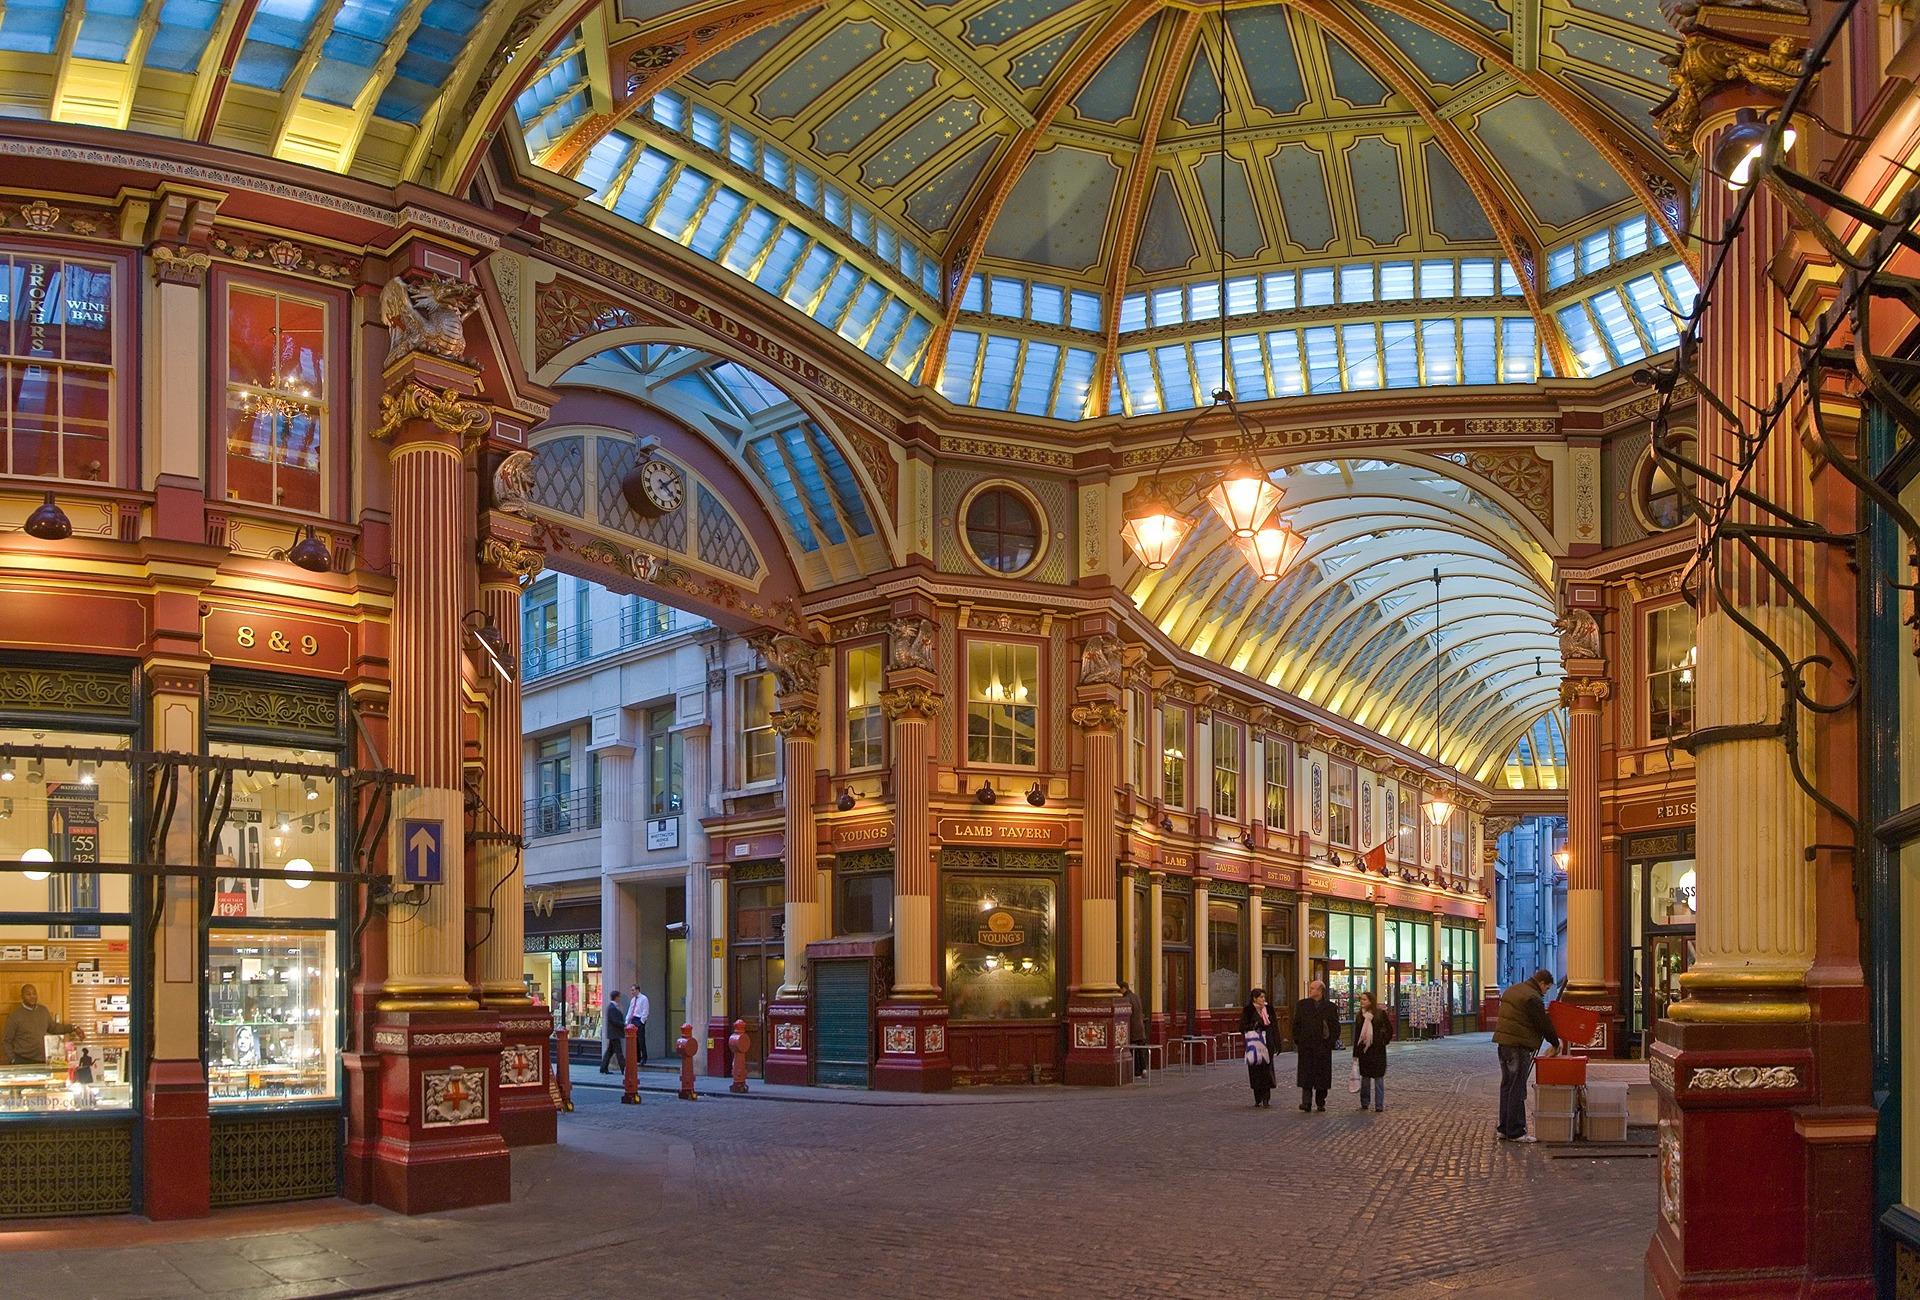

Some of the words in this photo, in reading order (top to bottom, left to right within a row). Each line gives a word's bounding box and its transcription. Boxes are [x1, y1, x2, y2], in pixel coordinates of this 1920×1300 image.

[30, 264, 45, 350] BROKERS
[66, 300, 110, 312] WINE
[73, 311, 104, 322] BAR
[755, 334, 807, 377] 1881
[1214, 420, 1455, 454] LEADENHALL
[237, 626, 255, 648] 8
[268, 630, 290, 652] &
[301, 635, 318, 655] 9
[840, 827, 888, 842] YOUNGS
[955, 824, 993, 836] LAMB
[999, 826, 1052, 839] TAVERN
[71, 835, 94, 851] £55
[1165, 856, 1187, 867] LAMB
[1215, 862, 1240, 874] TAVERN
[982, 932, 1021, 943] YOUNG'S
[1309, 929, 1326, 939] HOMAS
